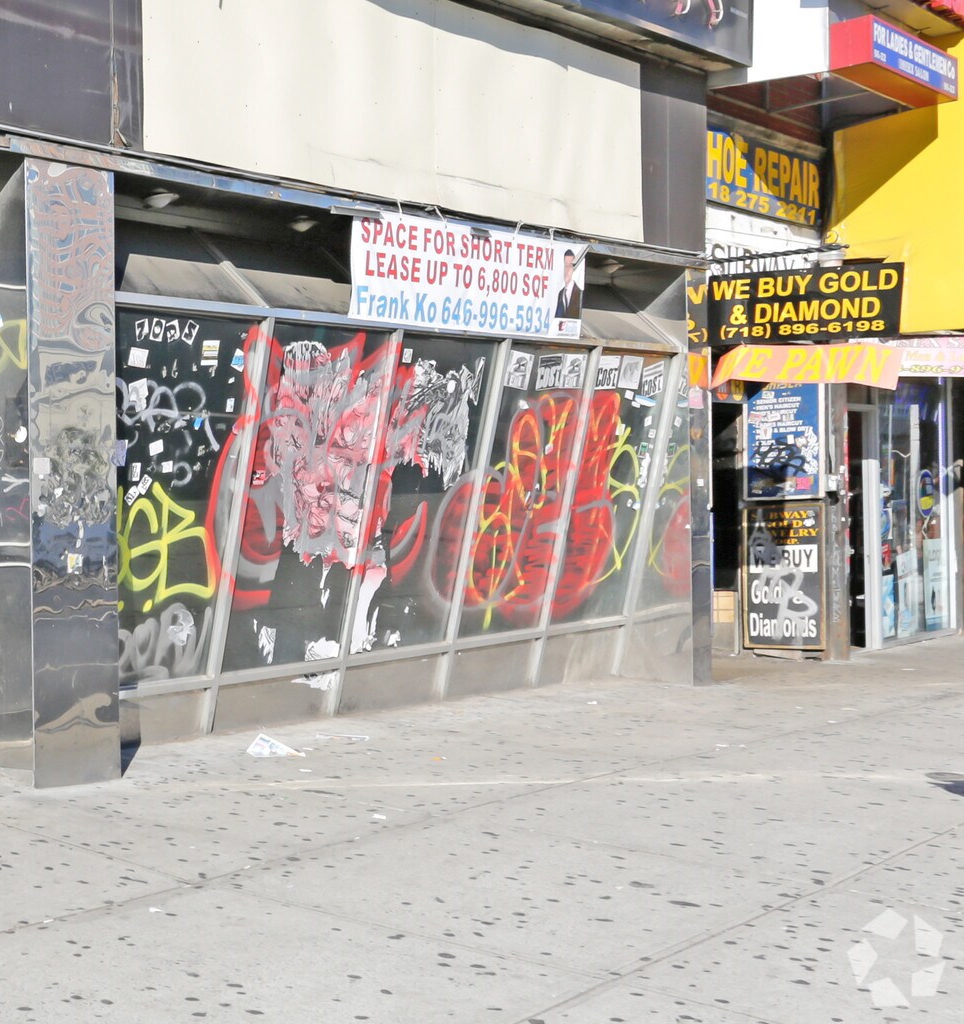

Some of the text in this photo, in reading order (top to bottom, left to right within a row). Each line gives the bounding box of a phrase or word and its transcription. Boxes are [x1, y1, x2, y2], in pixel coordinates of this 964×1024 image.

[873, 22, 886, 47] FOR
[754, 147, 820, 209] REPAIR
[735, 189, 770, 213] 275
[361, 217, 554, 271] SPACE FOR SHORT TERM
[365, 250, 549, 299] LEASE UP TO 6,800 SQF
[713, 268, 899, 301] WE BUY GOLD
[356, 285, 409, 321] Frank
[414, 293, 436, 324] Ko
[442, 296, 551, 333] 646-996-5934
[729, 296, 881, 325] & DIAMOND
[720, 319, 885, 339] (718) 896-6198
[596, 368, 618, 387] COST
[777, 346, 892, 384] PAWN
[782, 549, 813, 568] BUY
[751, 579, 782, 605] Gold
